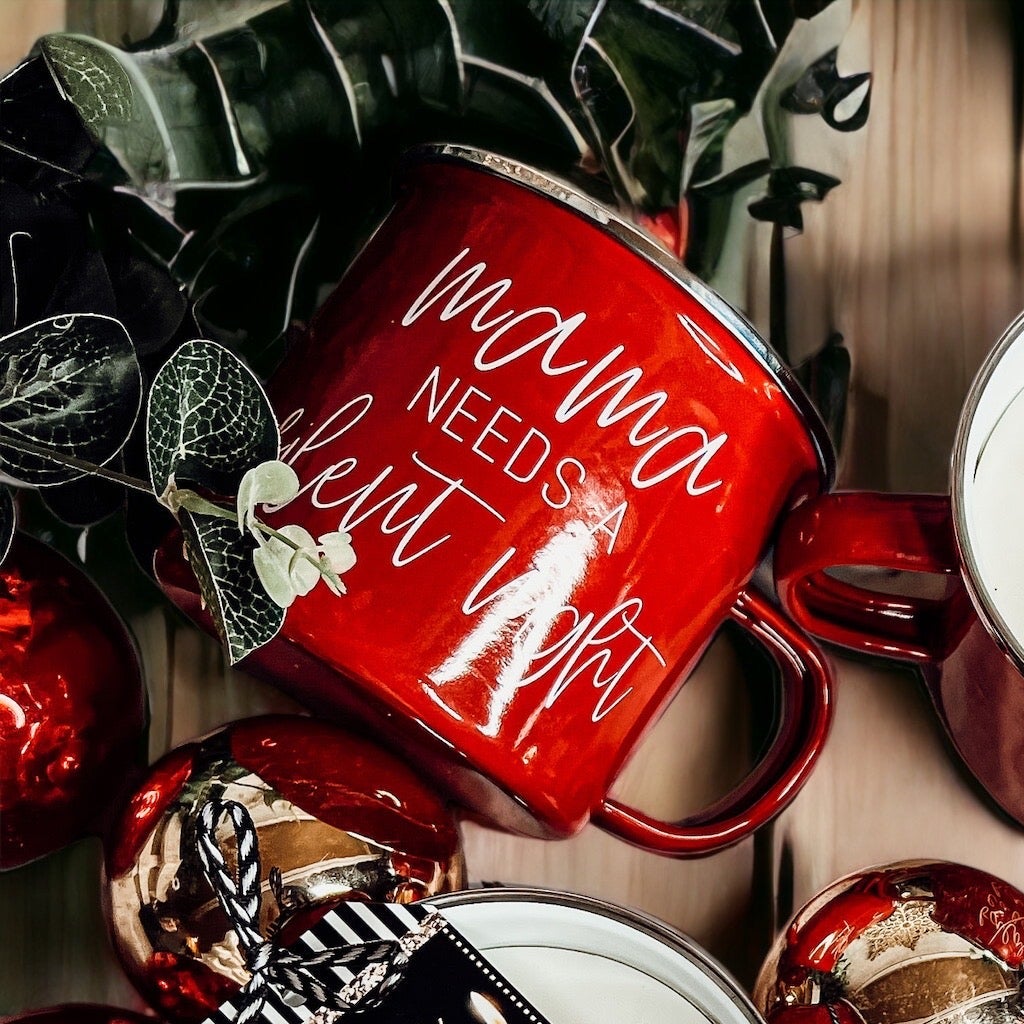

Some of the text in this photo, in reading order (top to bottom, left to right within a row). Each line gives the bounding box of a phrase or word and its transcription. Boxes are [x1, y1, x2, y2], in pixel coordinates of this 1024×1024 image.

[402, 247, 728, 496] mama
[407, 366, 628, 555] NEEDS A
